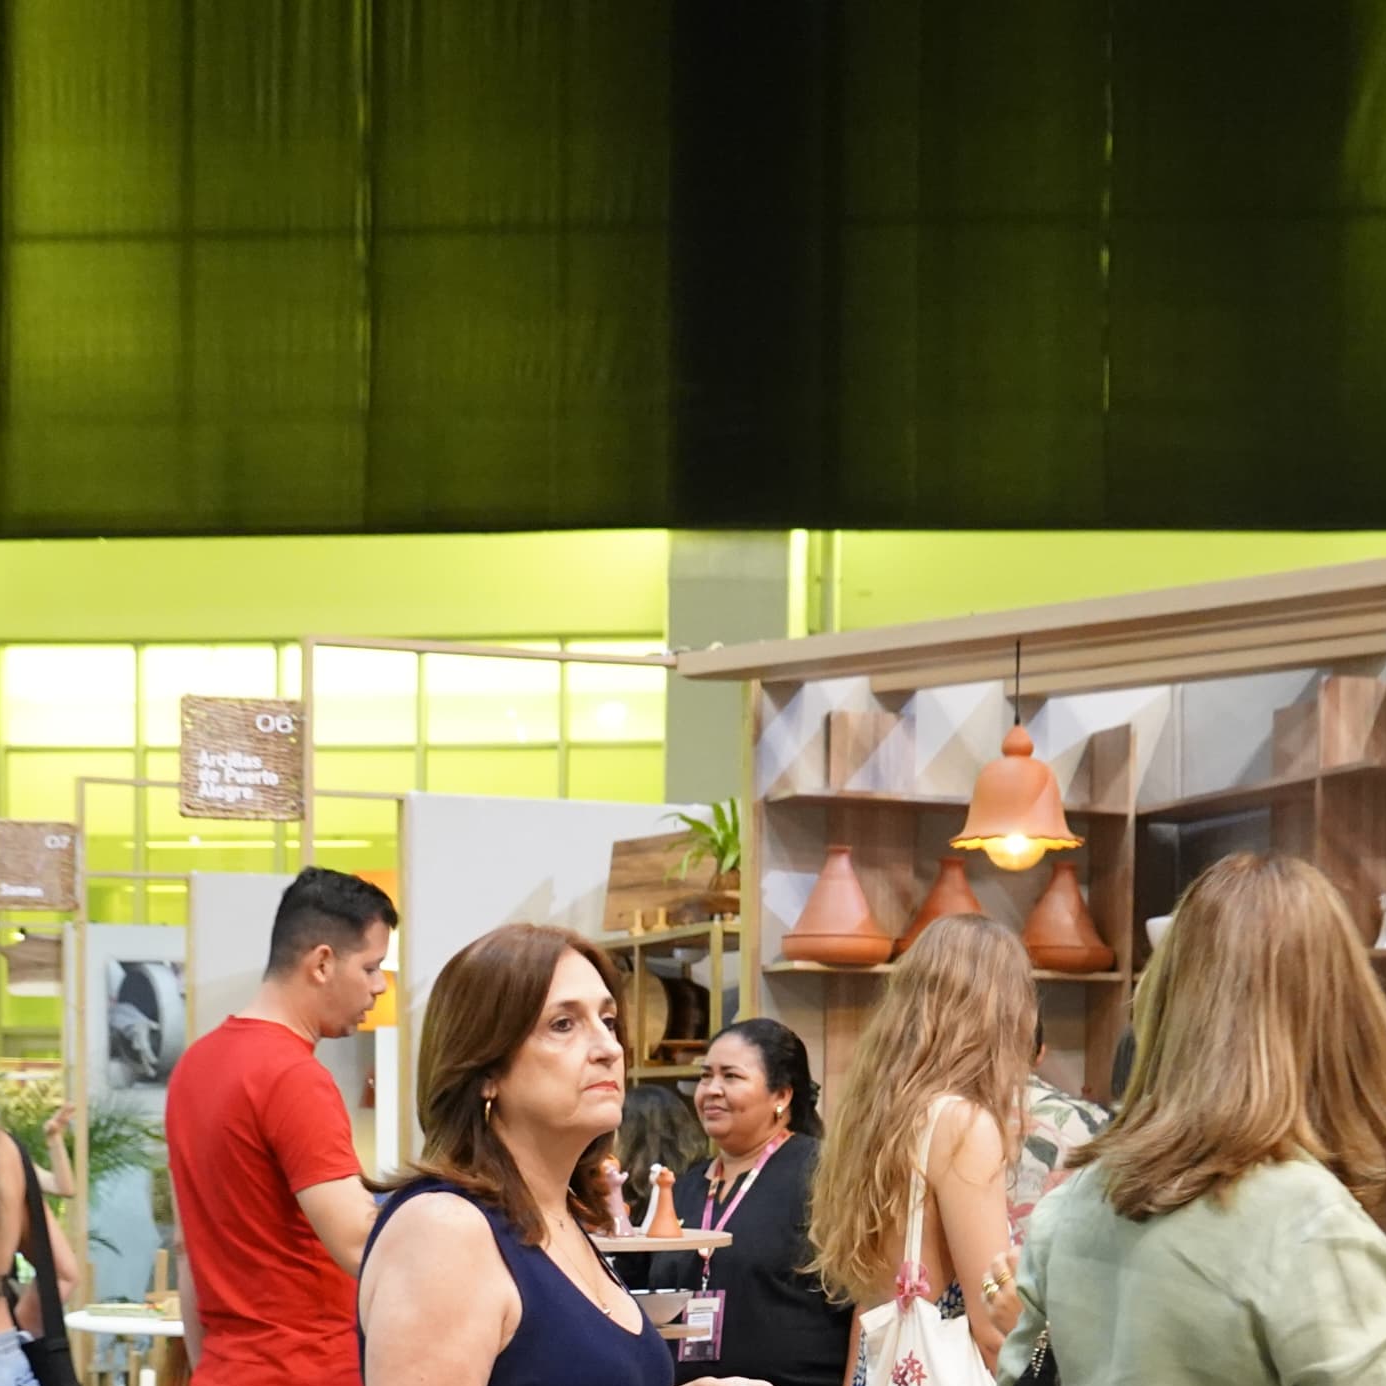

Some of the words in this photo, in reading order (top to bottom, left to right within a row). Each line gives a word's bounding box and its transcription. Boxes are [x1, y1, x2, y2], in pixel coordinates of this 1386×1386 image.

[255, 713, 294, 734] 06
[197, 749, 263, 769] Arcillas
[198, 767, 221, 784] de
[224, 767, 279, 786] Puerto
[198, 782, 254, 803] Alegre
